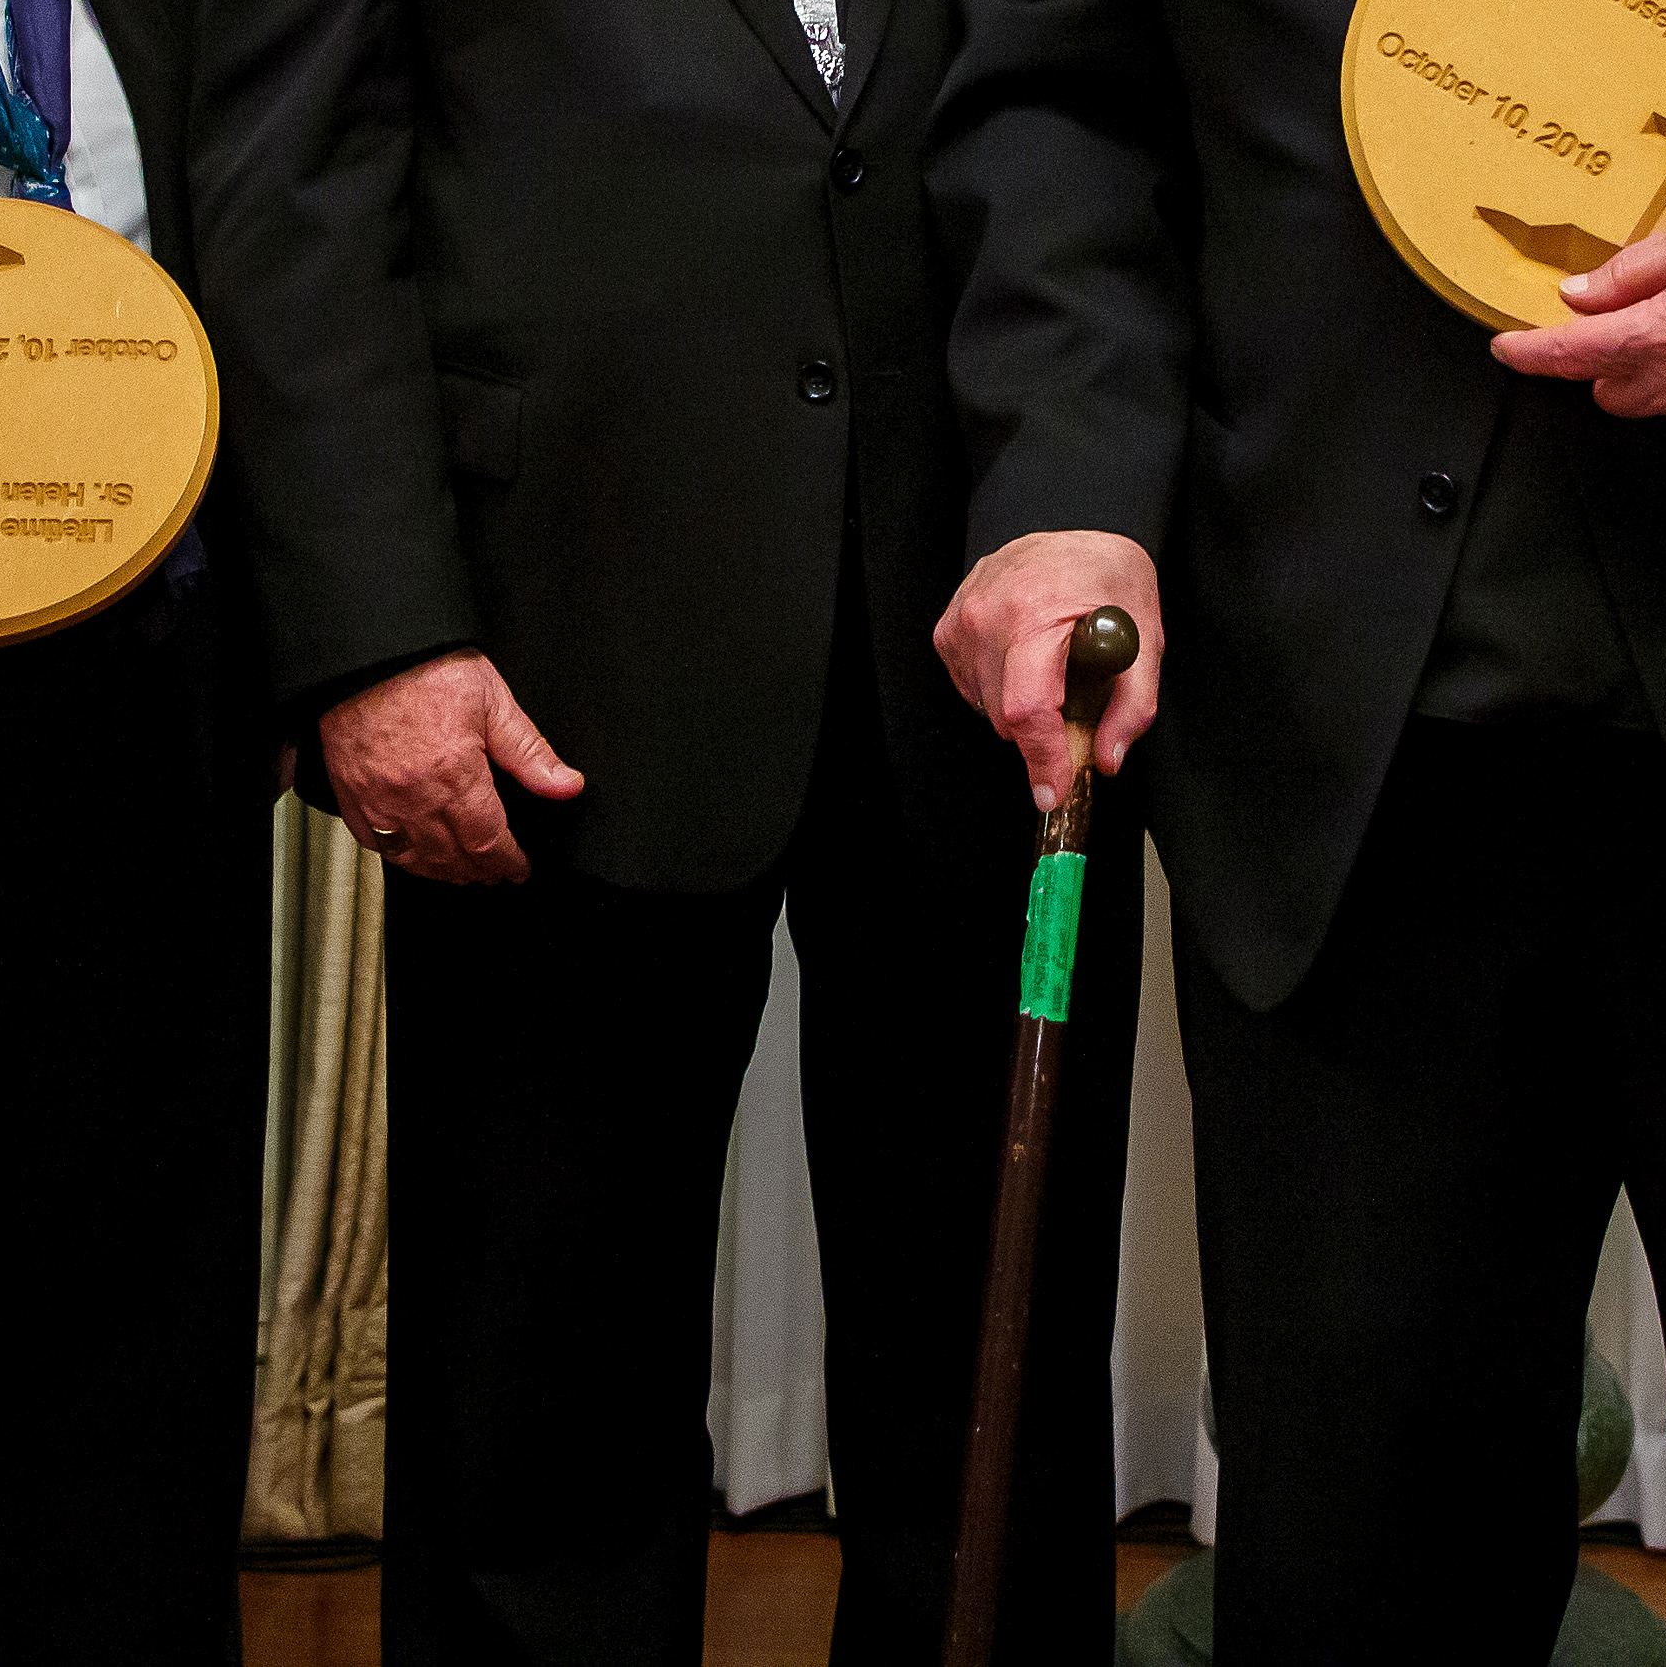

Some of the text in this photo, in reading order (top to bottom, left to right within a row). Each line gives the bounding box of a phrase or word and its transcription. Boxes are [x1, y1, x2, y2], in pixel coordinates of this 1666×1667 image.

[1377, 31, 1612, 177] October 10, 2019
[18, 334, 59, 362] 10,
[65, 337, 178, 362] October
[2, 482, 85, 507] Helen
[93, 483, 134, 506] Sr.
[0, 517, 114, 543] Lifetime
